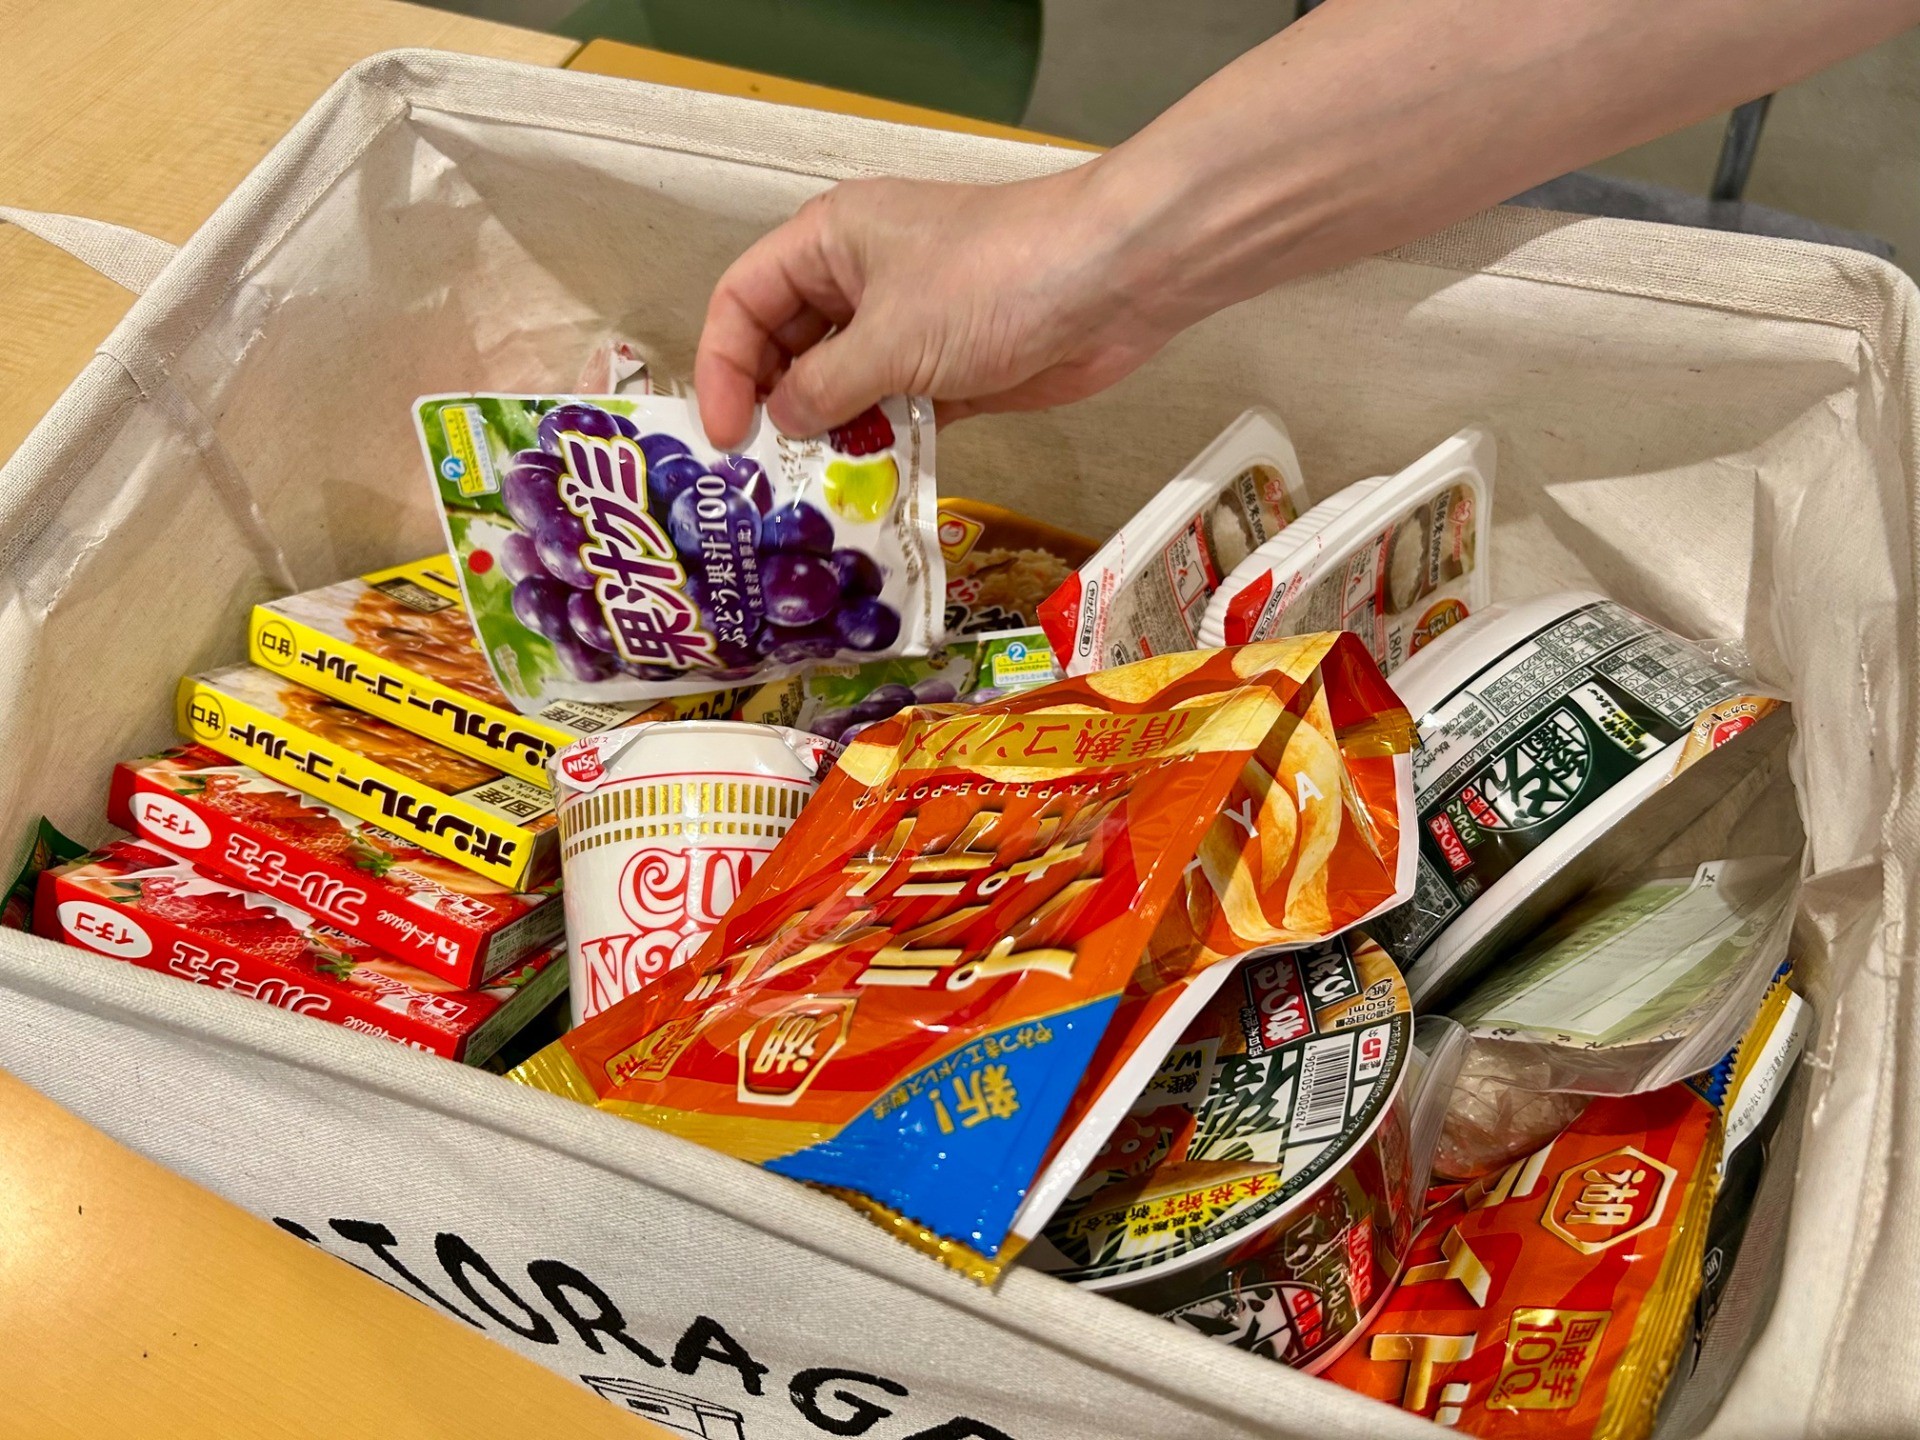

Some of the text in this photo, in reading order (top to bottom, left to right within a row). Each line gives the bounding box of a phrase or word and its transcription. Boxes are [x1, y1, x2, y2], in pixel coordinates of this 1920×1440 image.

[559, 433, 724, 668] 果汁グミ
[696, 475, 748, 648] ぶどう果汁100
[257, 630, 294, 657] 甘口
[1012, 646, 1022, 660] 2
[186, 701, 224, 730] 甘口
[539, 706, 608, 733] 国産
[902, 711, 1189, 761] 情熱コンソメ
[472, 787, 542, 818] 国産
[956, 781, 1053, 798] PRIDE
[141, 801, 198, 839] イチゴ
[1444, 798, 1480, 845] うどん
[1428, 815, 1467, 868] きつね
[225, 832, 367, 925] フルーチェ
[619, 847, 773, 930] CU
[72, 910, 136, 950] イチゴ
[370, 906, 438, 953] House
[1252, 958, 1306, 1045] きつね
[1334, 1006, 1395, 1026] お湯の目安量
[1347, 996, 1395, 1015] 350ml
[1358, 1059, 1382, 1070] 熱湯
[1360, 1029, 1383, 1060] 5 分
[1299, 1052, 1317, 1089] 902105
[1294, 1091, 1311, 1131] 002674
[1566, 1167, 1647, 1231] 湖
[1132, 1209, 1206, 1237] 高級鰹節
[273, 1216, 1012, 1440] TORAG
[1495, 1316, 1562, 1402] 100%
[1541, 1319, 1602, 1402] 国産芋
